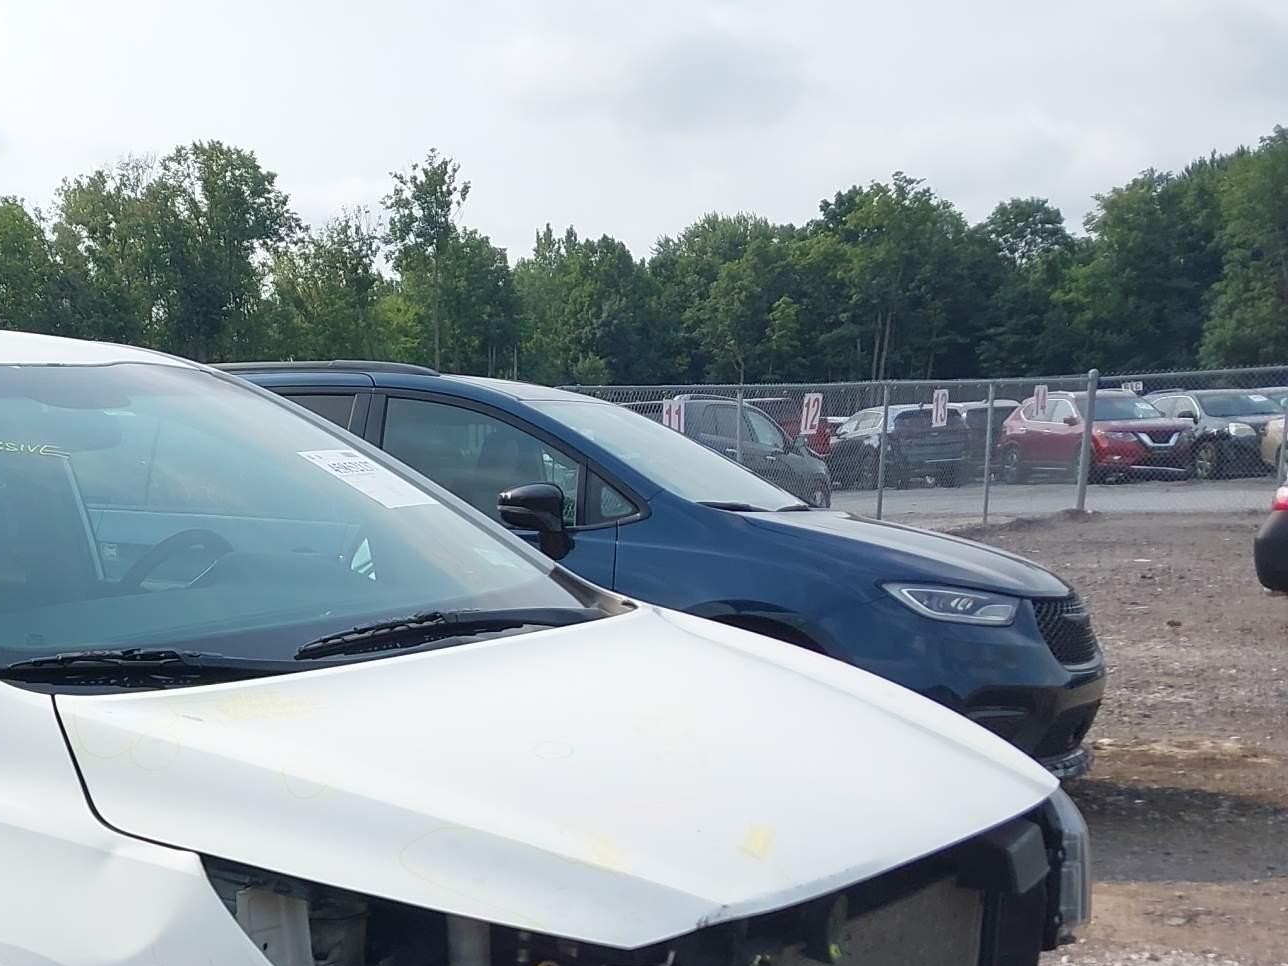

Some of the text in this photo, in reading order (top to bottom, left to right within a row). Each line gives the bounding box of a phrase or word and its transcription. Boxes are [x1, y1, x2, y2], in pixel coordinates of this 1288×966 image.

[665, 403, 681, 431] 11
[804, 397, 820, 430] 12
[935, 393, 947, 422] 13
